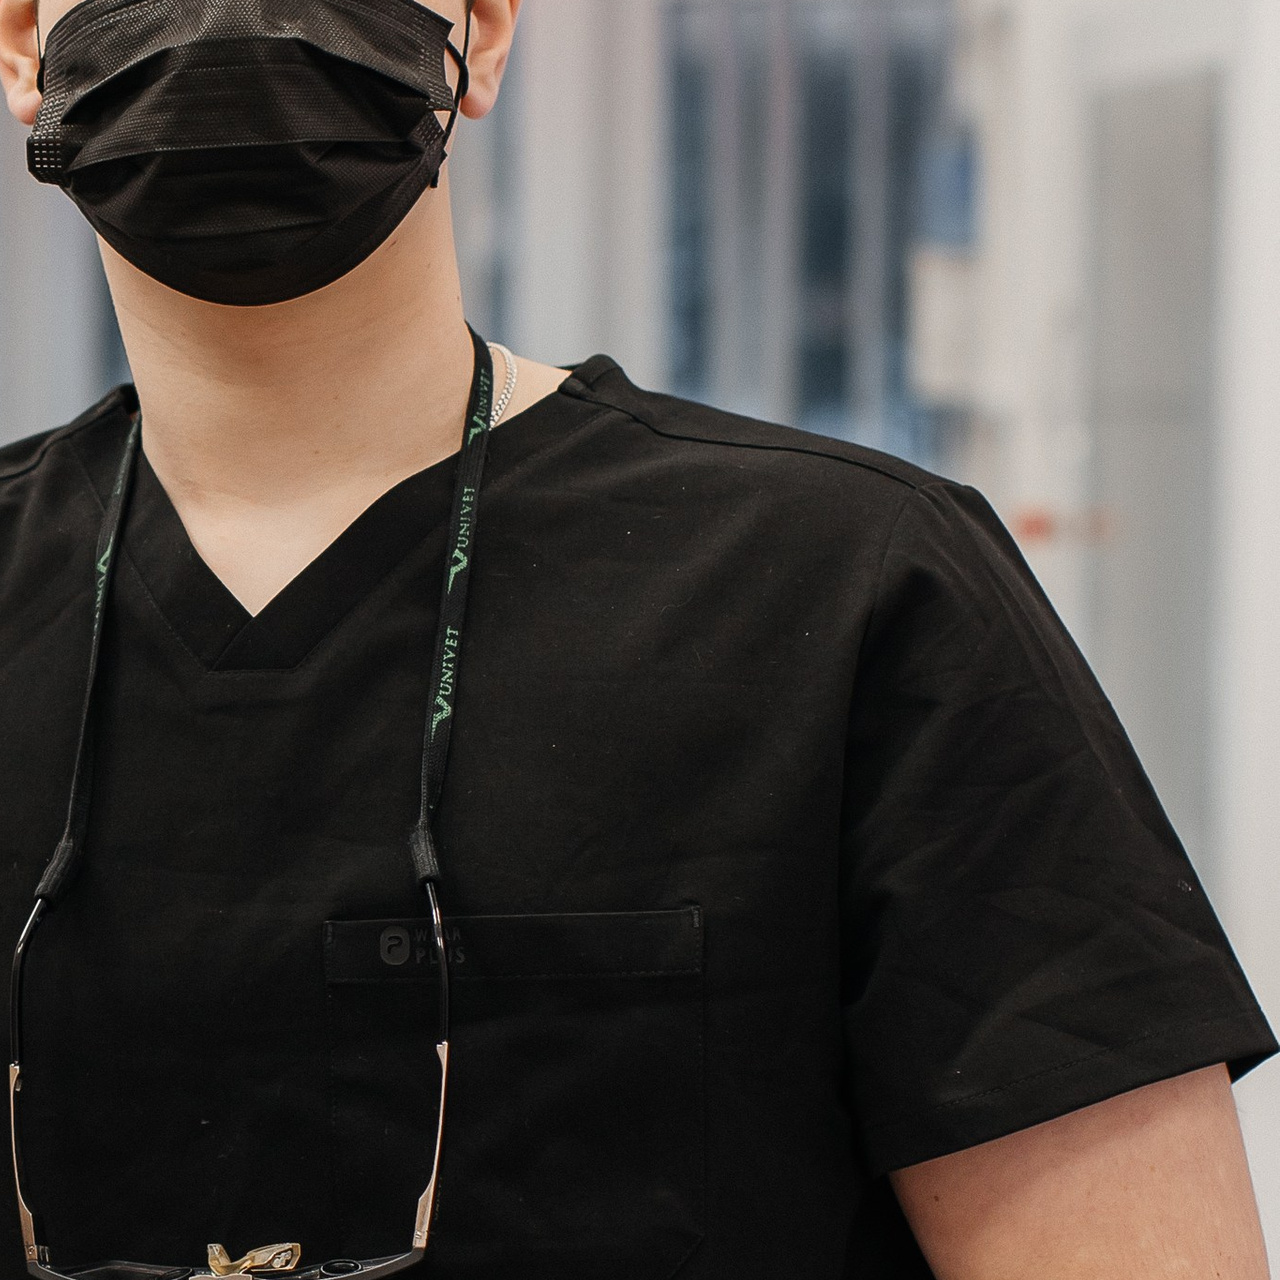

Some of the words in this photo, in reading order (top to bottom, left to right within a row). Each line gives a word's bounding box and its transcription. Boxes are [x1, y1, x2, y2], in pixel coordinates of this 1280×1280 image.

[457, 486, 475, 548] UNIVET
[439, 625, 459, 695] UNIVET
[414, 927, 461, 941] WR
